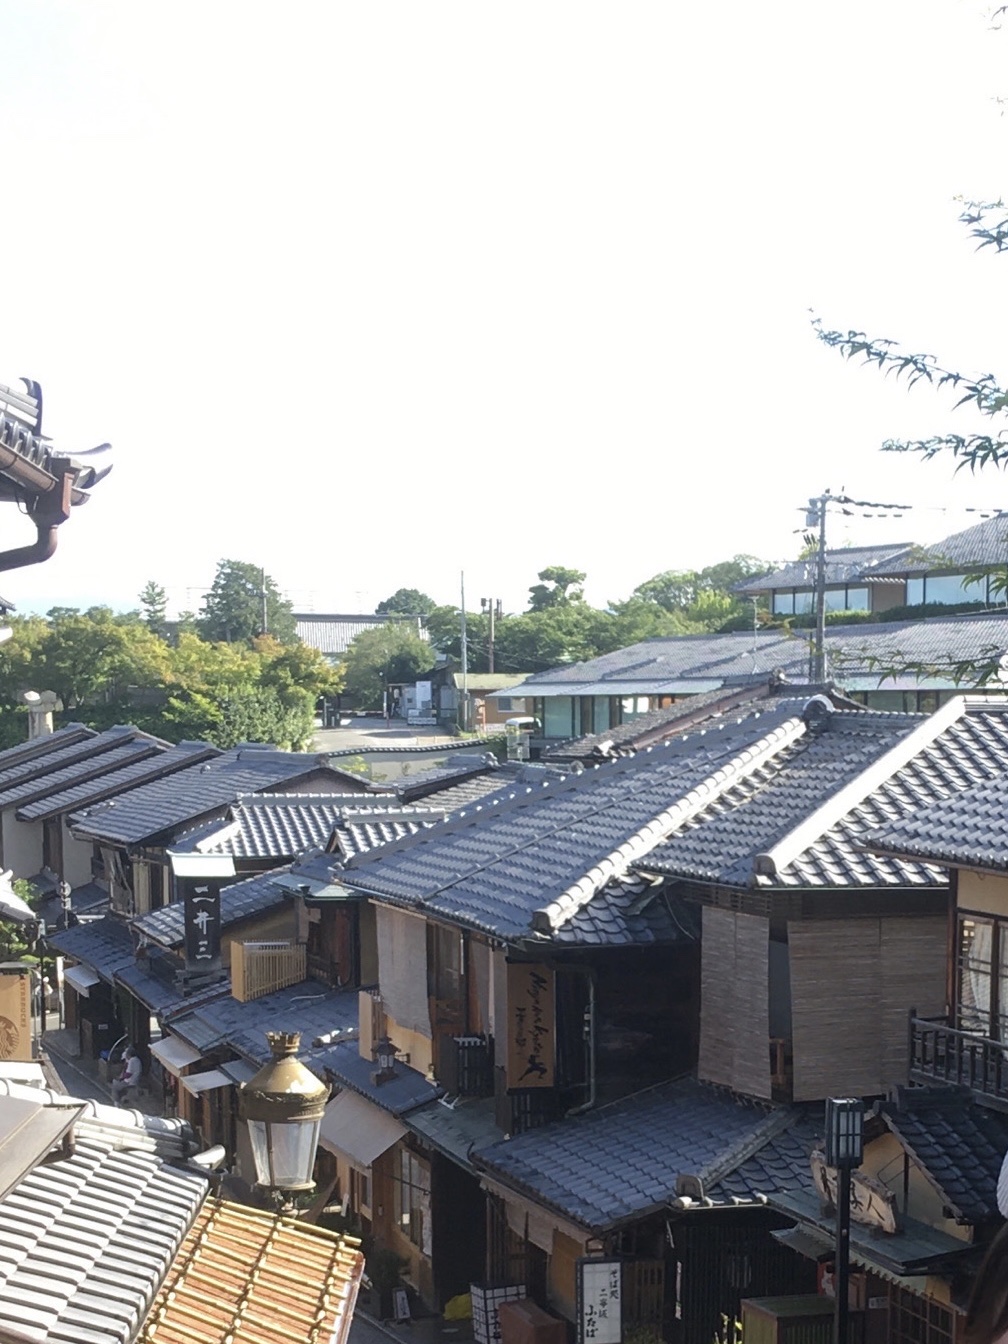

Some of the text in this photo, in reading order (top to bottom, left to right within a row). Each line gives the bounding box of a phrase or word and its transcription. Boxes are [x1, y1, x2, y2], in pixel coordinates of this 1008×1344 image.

[609, 1269, 619, 1300] そば処
[585, 1304, 599, 1338] ふたば
